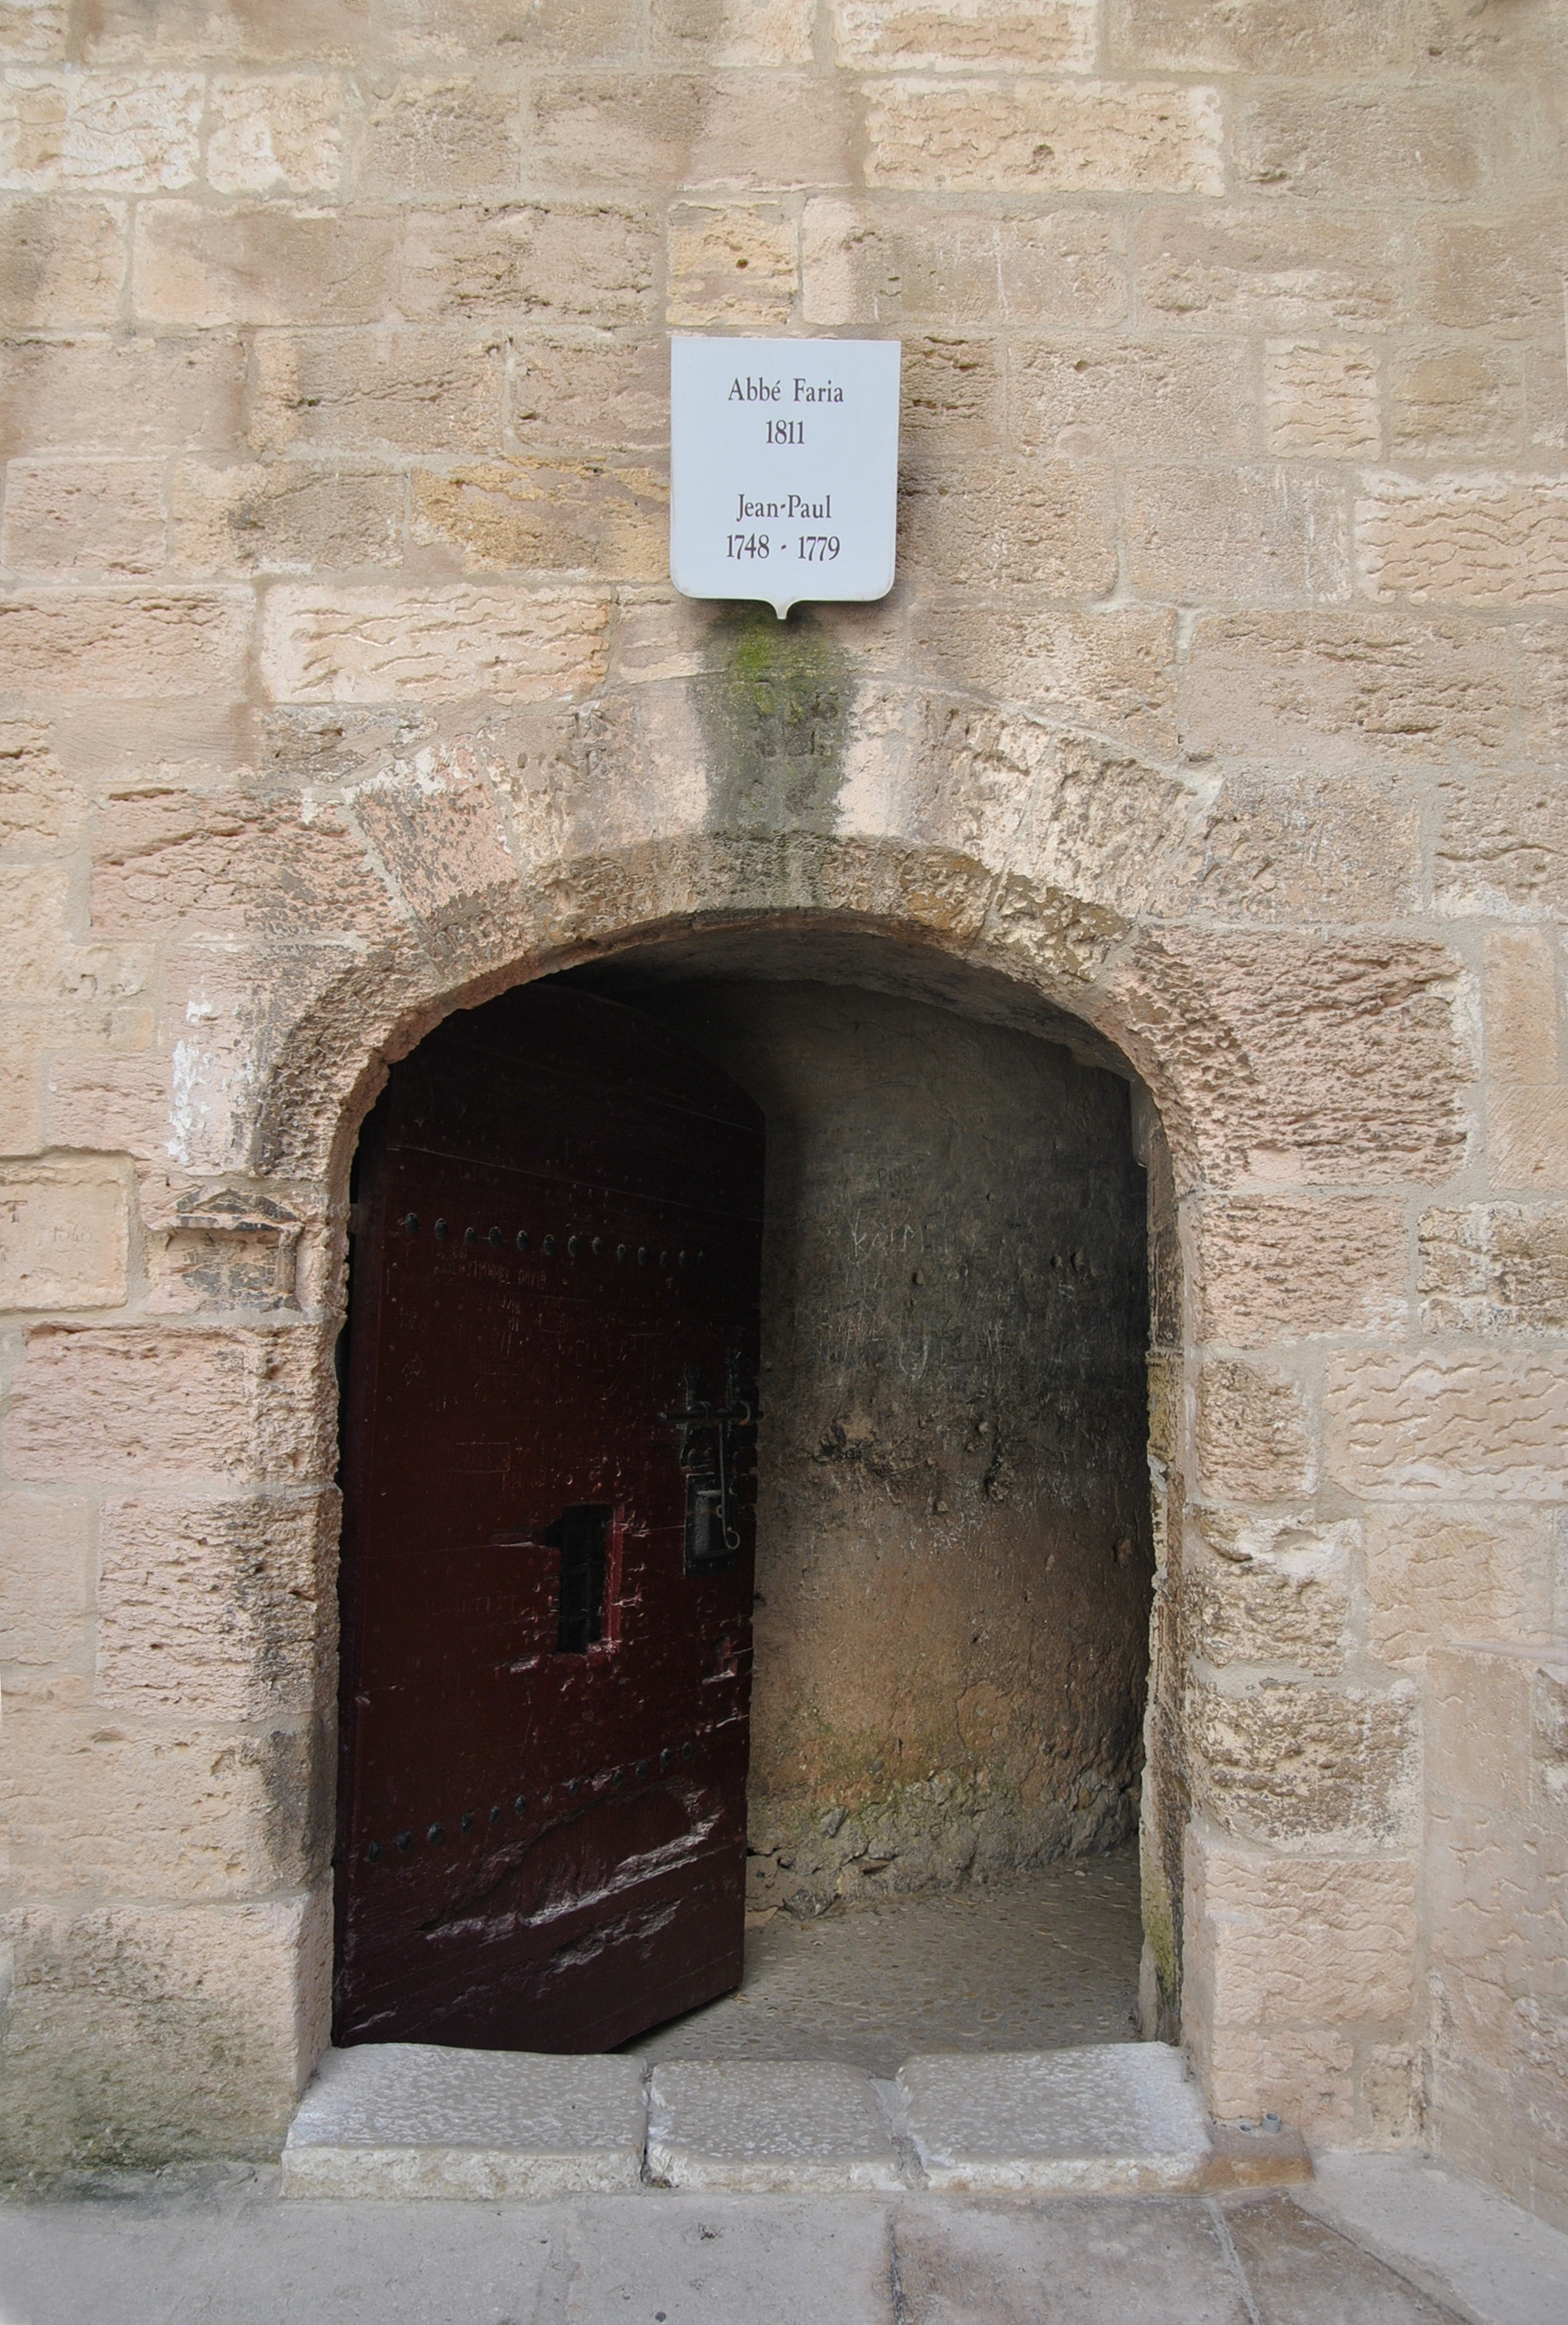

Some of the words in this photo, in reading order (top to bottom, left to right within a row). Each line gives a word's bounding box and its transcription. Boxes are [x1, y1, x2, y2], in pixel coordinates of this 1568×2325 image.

[728, 376, 781, 401] Abbé
[793, 378, 844, 403] Faria
[766, 420, 805, 445] 1811
[736, 493, 832, 522] Jean-Paul
[726, 533, 770, 561] 1748
[797, 535, 841, 562] 1779
